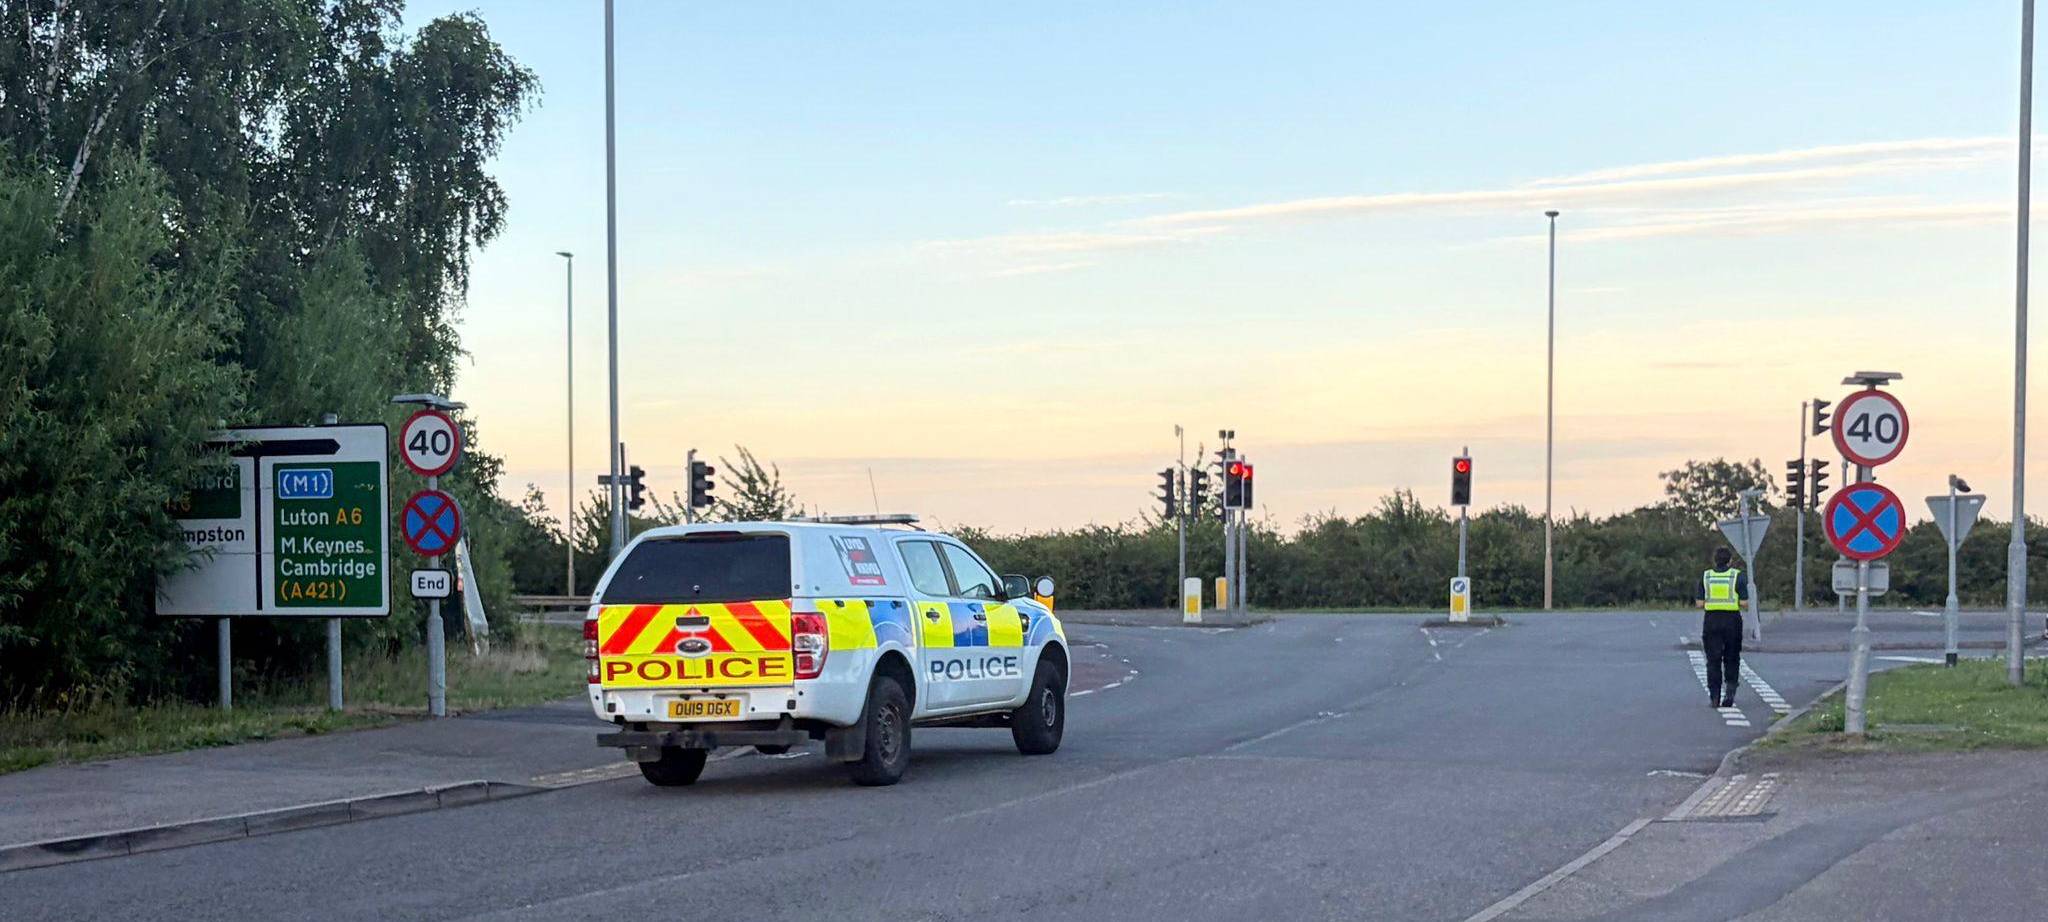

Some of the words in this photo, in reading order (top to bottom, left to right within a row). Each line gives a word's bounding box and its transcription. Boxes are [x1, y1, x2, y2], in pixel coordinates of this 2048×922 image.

[1847, 412, 1900, 444] 40
[408, 429, 452, 457] 40
[282, 473, 329, 495] (M1)
[280, 508, 329, 526] Luton
[335, 507, 363, 525] A6
[183, 525, 246, 545] mpston
[280, 536, 365, 558] M.Keynes
[280, 558, 377, 579] Cambridge
[280, 580, 347, 602] (A421)
[417, 577, 445, 590] End
[606, 657, 787, 682] POLICE
[931, 656, 1018, 681] POLICE
[675, 702, 704, 716] OU19
[707, 702, 733, 715] DGX
